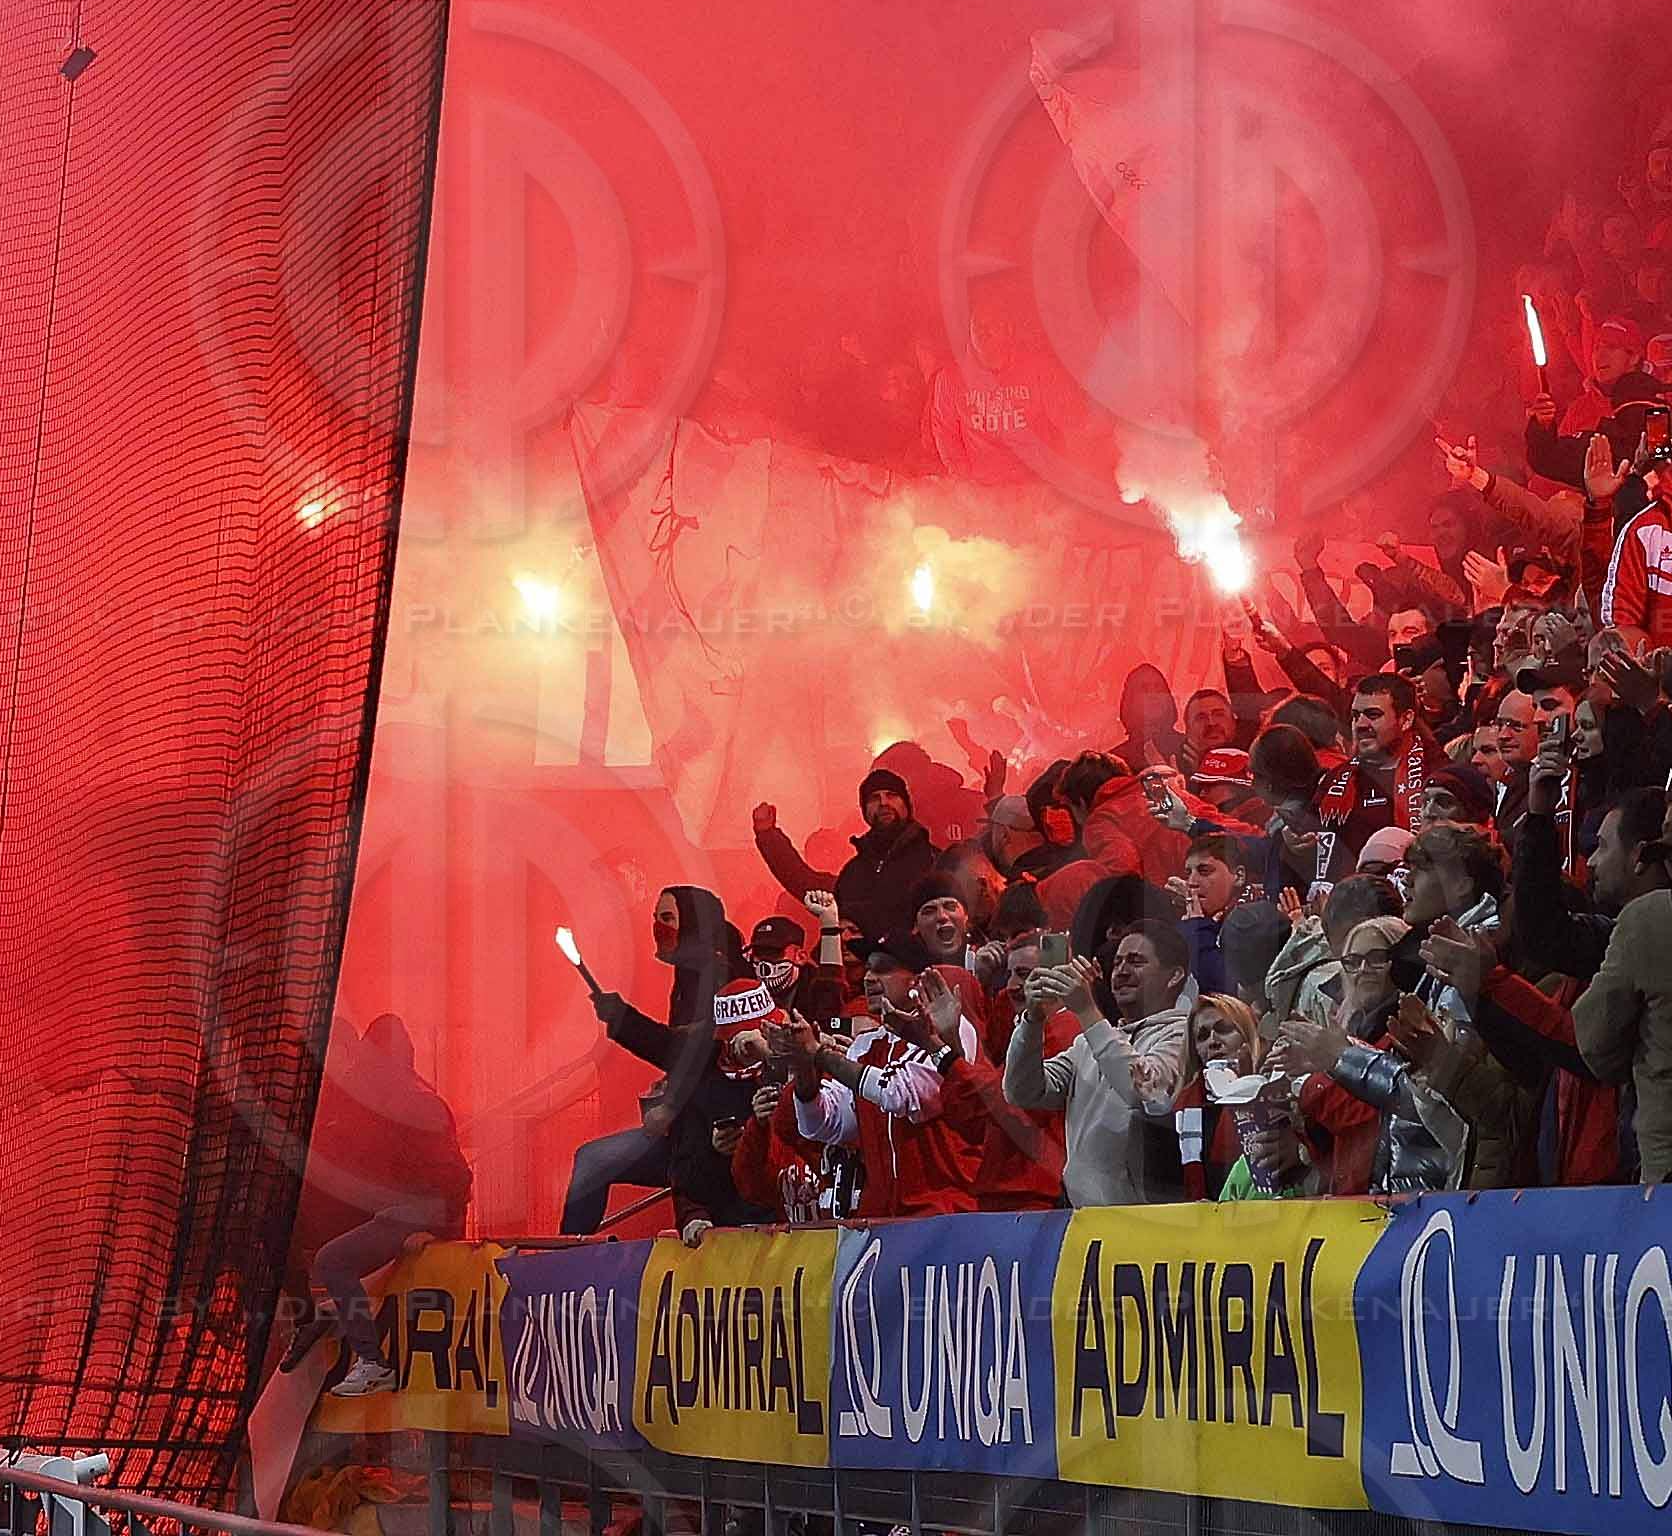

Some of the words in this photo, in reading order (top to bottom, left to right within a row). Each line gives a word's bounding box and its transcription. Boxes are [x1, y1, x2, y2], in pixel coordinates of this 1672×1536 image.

[644, 1265, 825, 1435] ADMIRAL
[900, 1256, 1033, 1447] UNIQA
[1070, 1239, 1345, 1458] ADMIRAL
